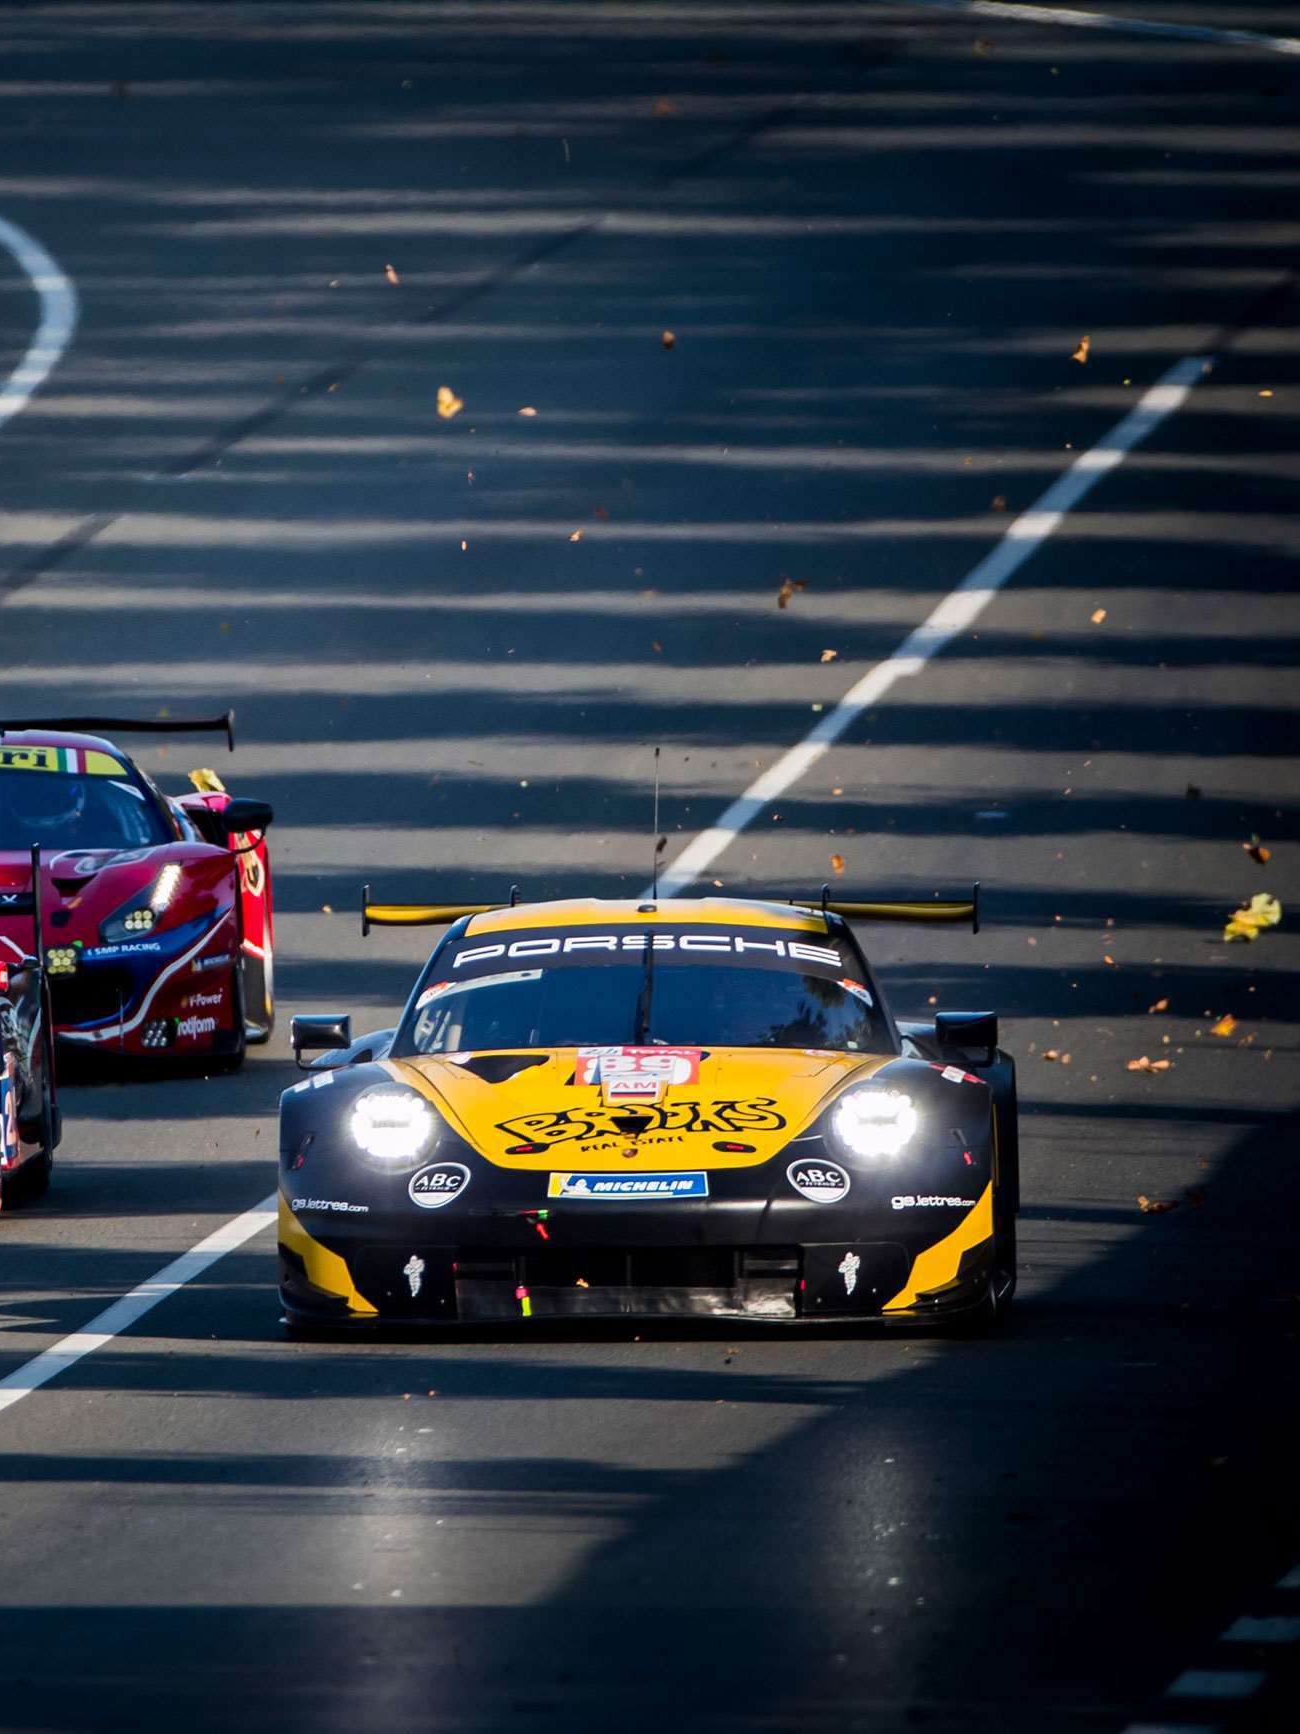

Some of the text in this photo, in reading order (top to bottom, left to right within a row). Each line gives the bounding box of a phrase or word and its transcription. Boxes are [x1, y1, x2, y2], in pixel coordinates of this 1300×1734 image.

[121, 942, 161, 952] RACING
[453, 935, 842, 968] PORSCHE
[583, 1055, 693, 1085] 89
[613, 1081, 657, 1089] AM
[415, 1173, 461, 1187] ABC
[797, 1169, 841, 1183] ABC
[593, 1180, 693, 1192] MICHELIN
